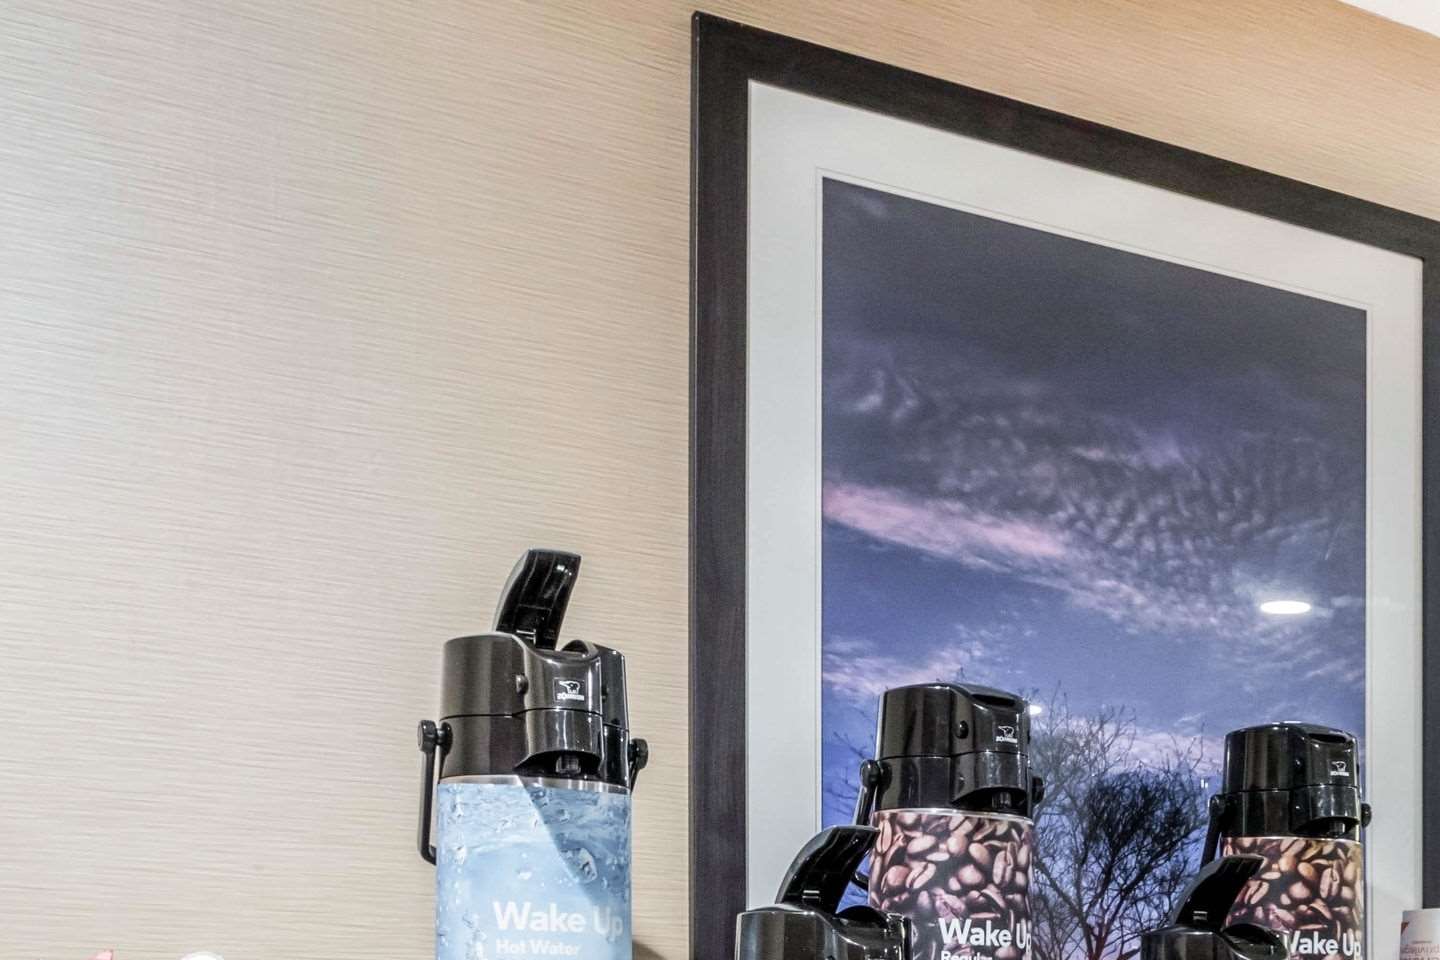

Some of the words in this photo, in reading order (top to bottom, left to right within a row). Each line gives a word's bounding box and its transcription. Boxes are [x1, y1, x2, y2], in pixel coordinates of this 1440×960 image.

[493, 901, 587, 932] Wake
[593, 905, 624, 942] Up
[938, 918, 1012, 947] Wake
[1016, 921, 1031, 956] Up
[496, 940, 527, 954] Hot
[529, 940, 577, 956] Water
[1343, 932, 1361, 960] Up
